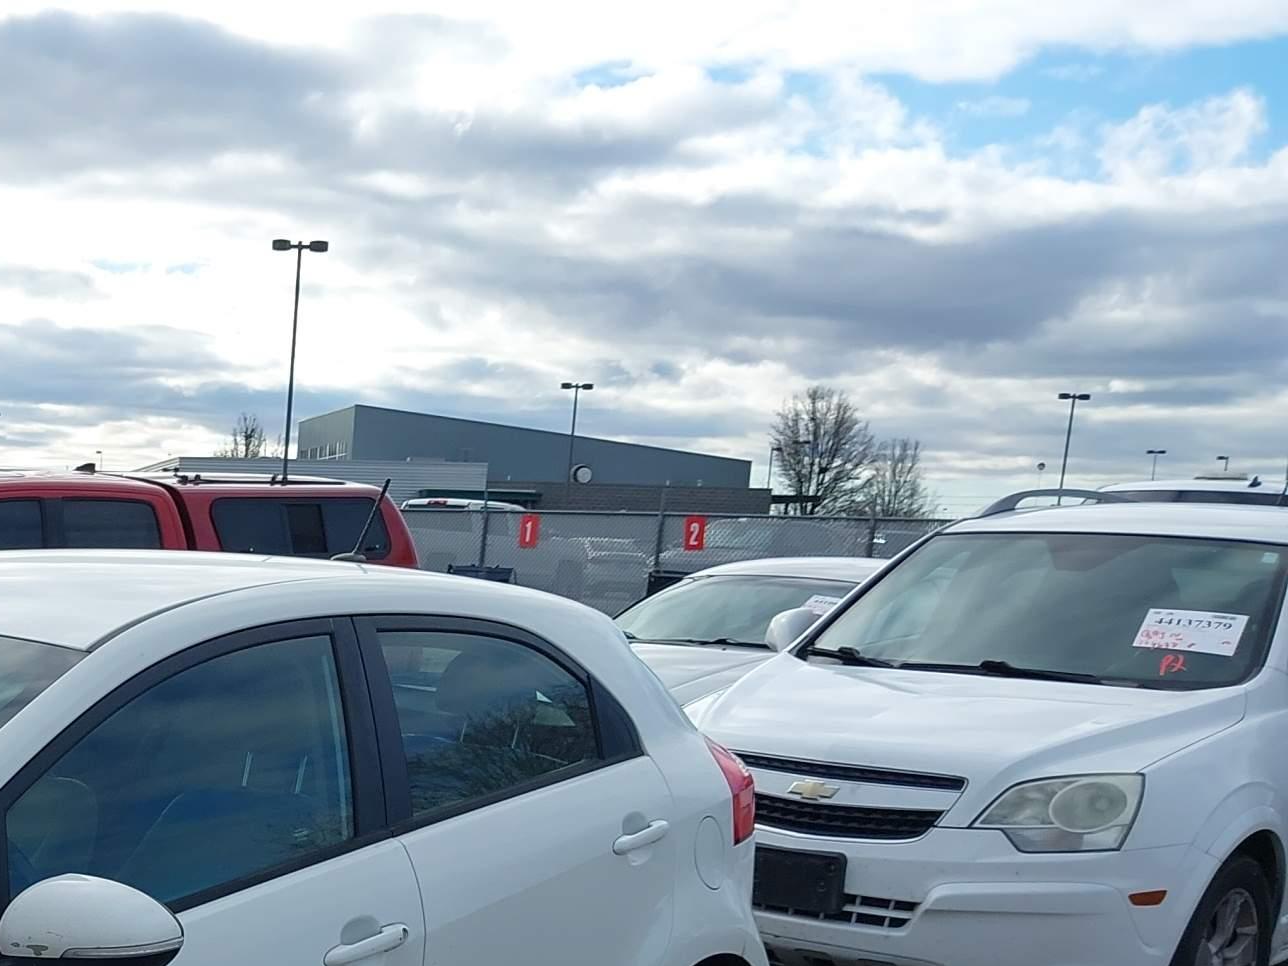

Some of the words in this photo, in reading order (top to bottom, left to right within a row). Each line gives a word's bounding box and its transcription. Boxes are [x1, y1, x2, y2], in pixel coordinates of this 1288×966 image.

[524, 520, 533, 543] 1
[688, 522, 700, 545] 2
[1154, 617, 1233, 631] 44137379
